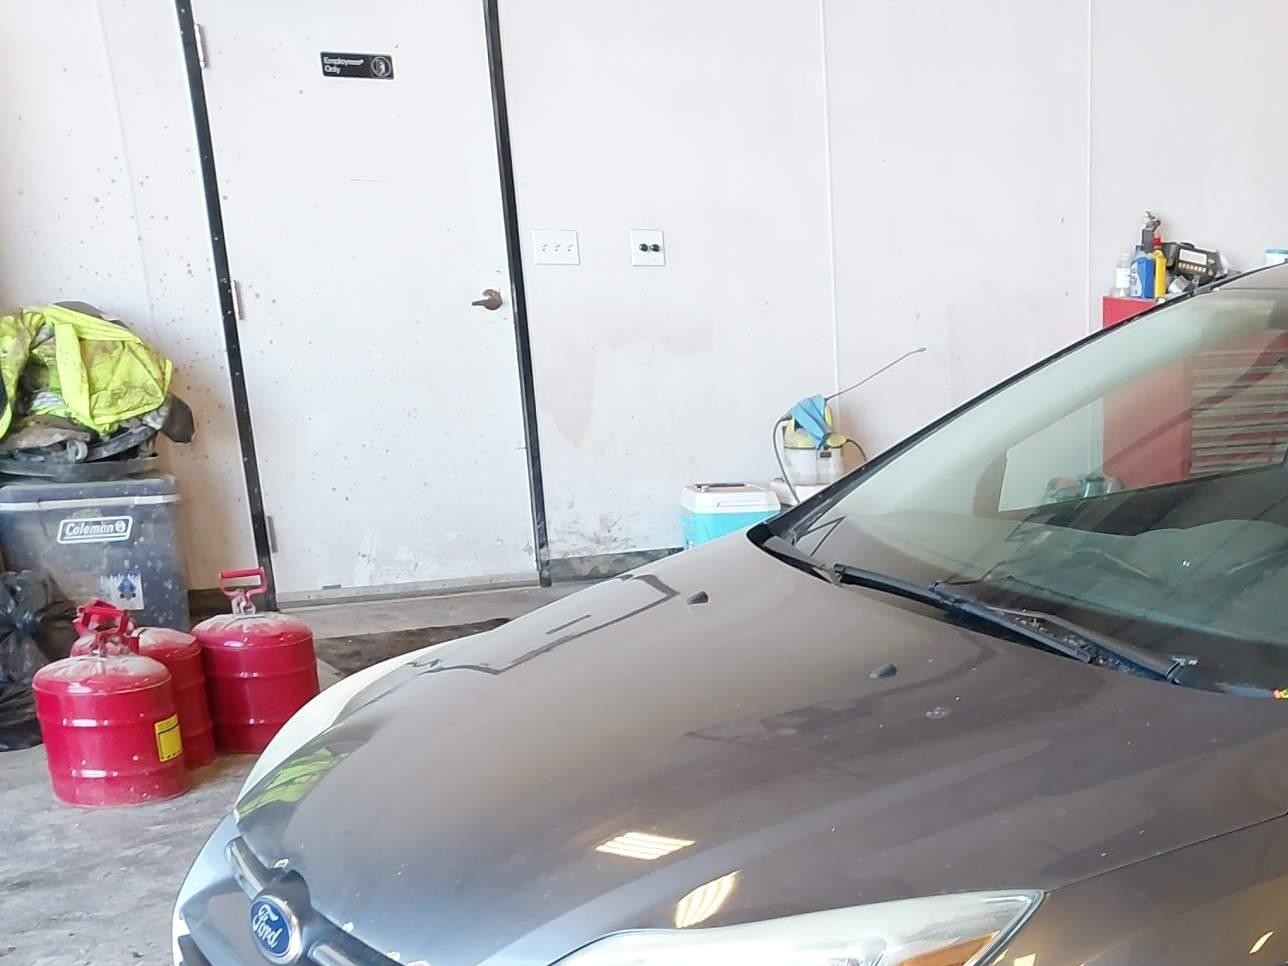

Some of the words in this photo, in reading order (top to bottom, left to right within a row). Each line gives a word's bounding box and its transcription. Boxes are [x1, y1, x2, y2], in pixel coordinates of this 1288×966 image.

[325, 65, 341, 74] Only
[66, 522, 114, 536] Coleman
[252, 904, 283, 949] Ford
